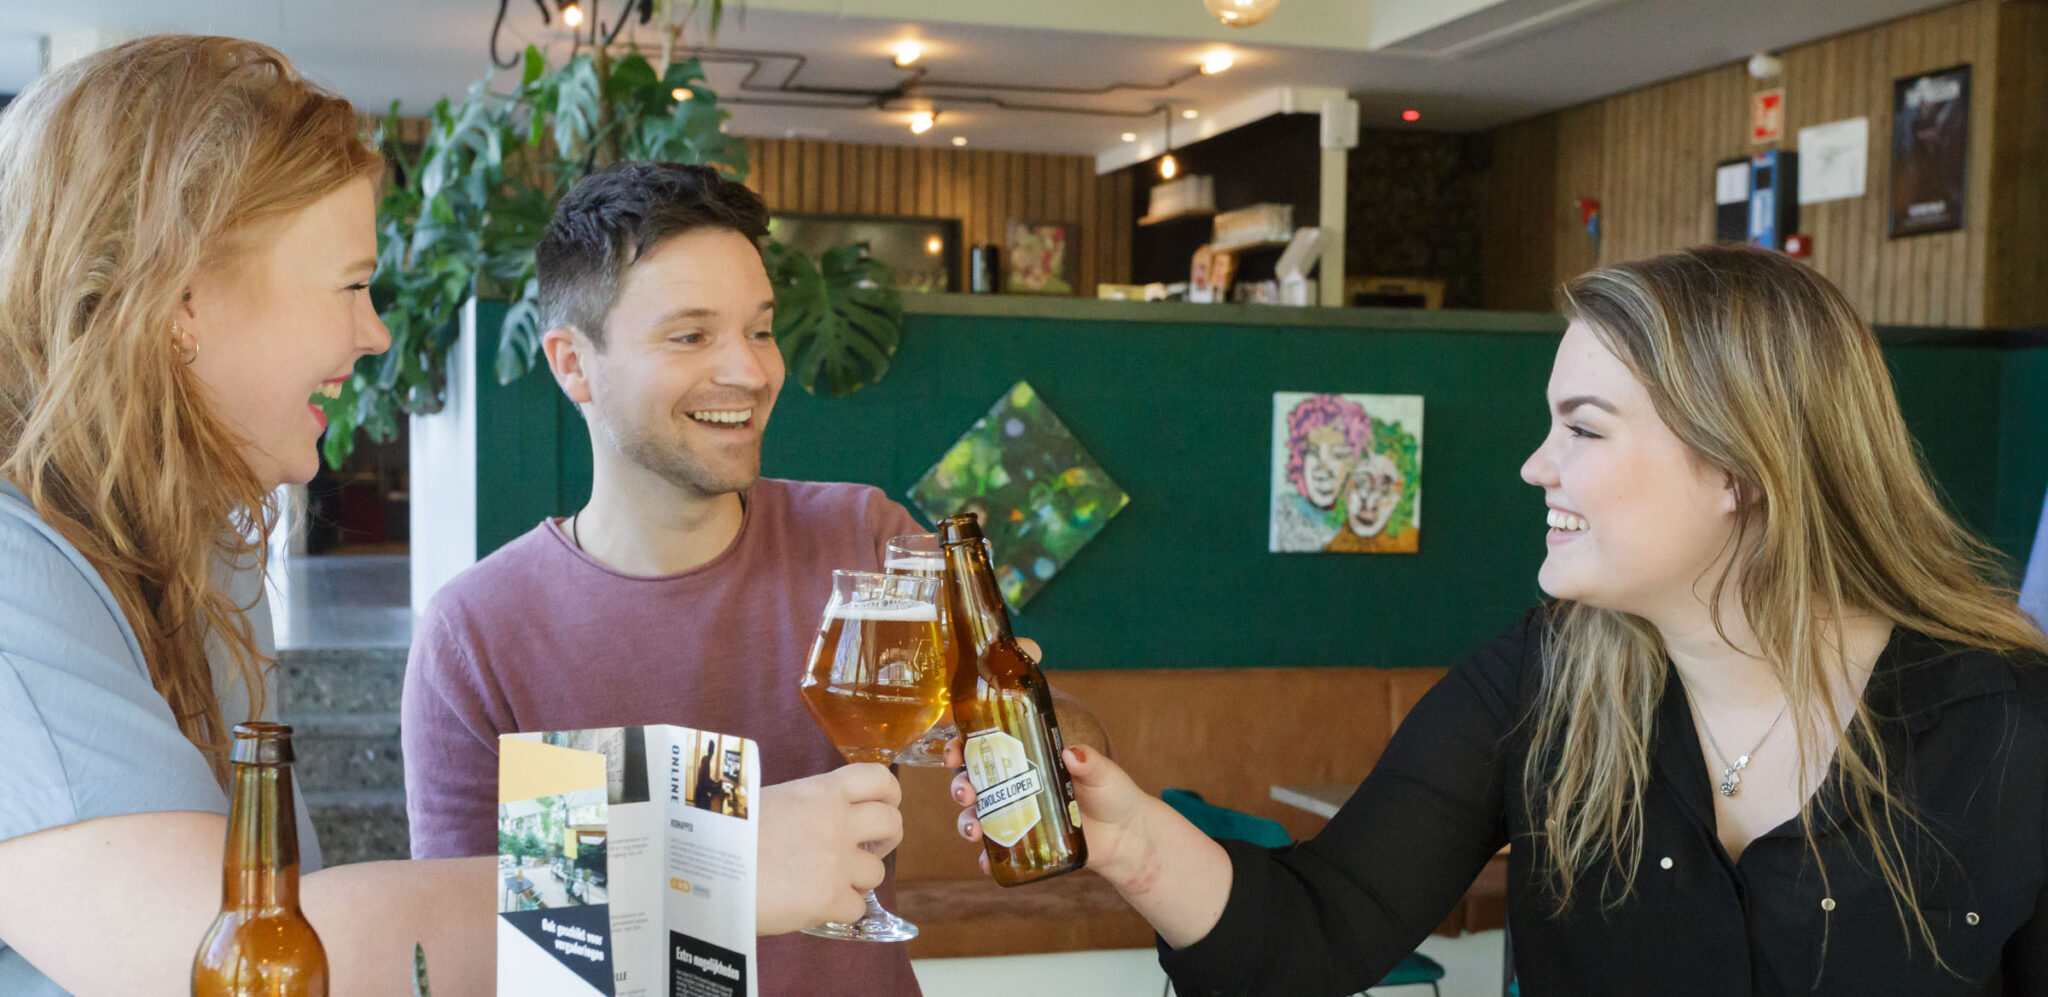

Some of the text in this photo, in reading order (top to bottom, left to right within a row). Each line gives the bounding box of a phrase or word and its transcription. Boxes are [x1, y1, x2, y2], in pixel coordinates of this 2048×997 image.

[671, 744, 680, 804] ONLINE
[980, 789, 1006, 810] ZWOLSE
[1006, 777, 1033, 798] LOPER
[586, 932, 603, 946] voor
[676, 946, 740, 981] Extra mogelijkheden
